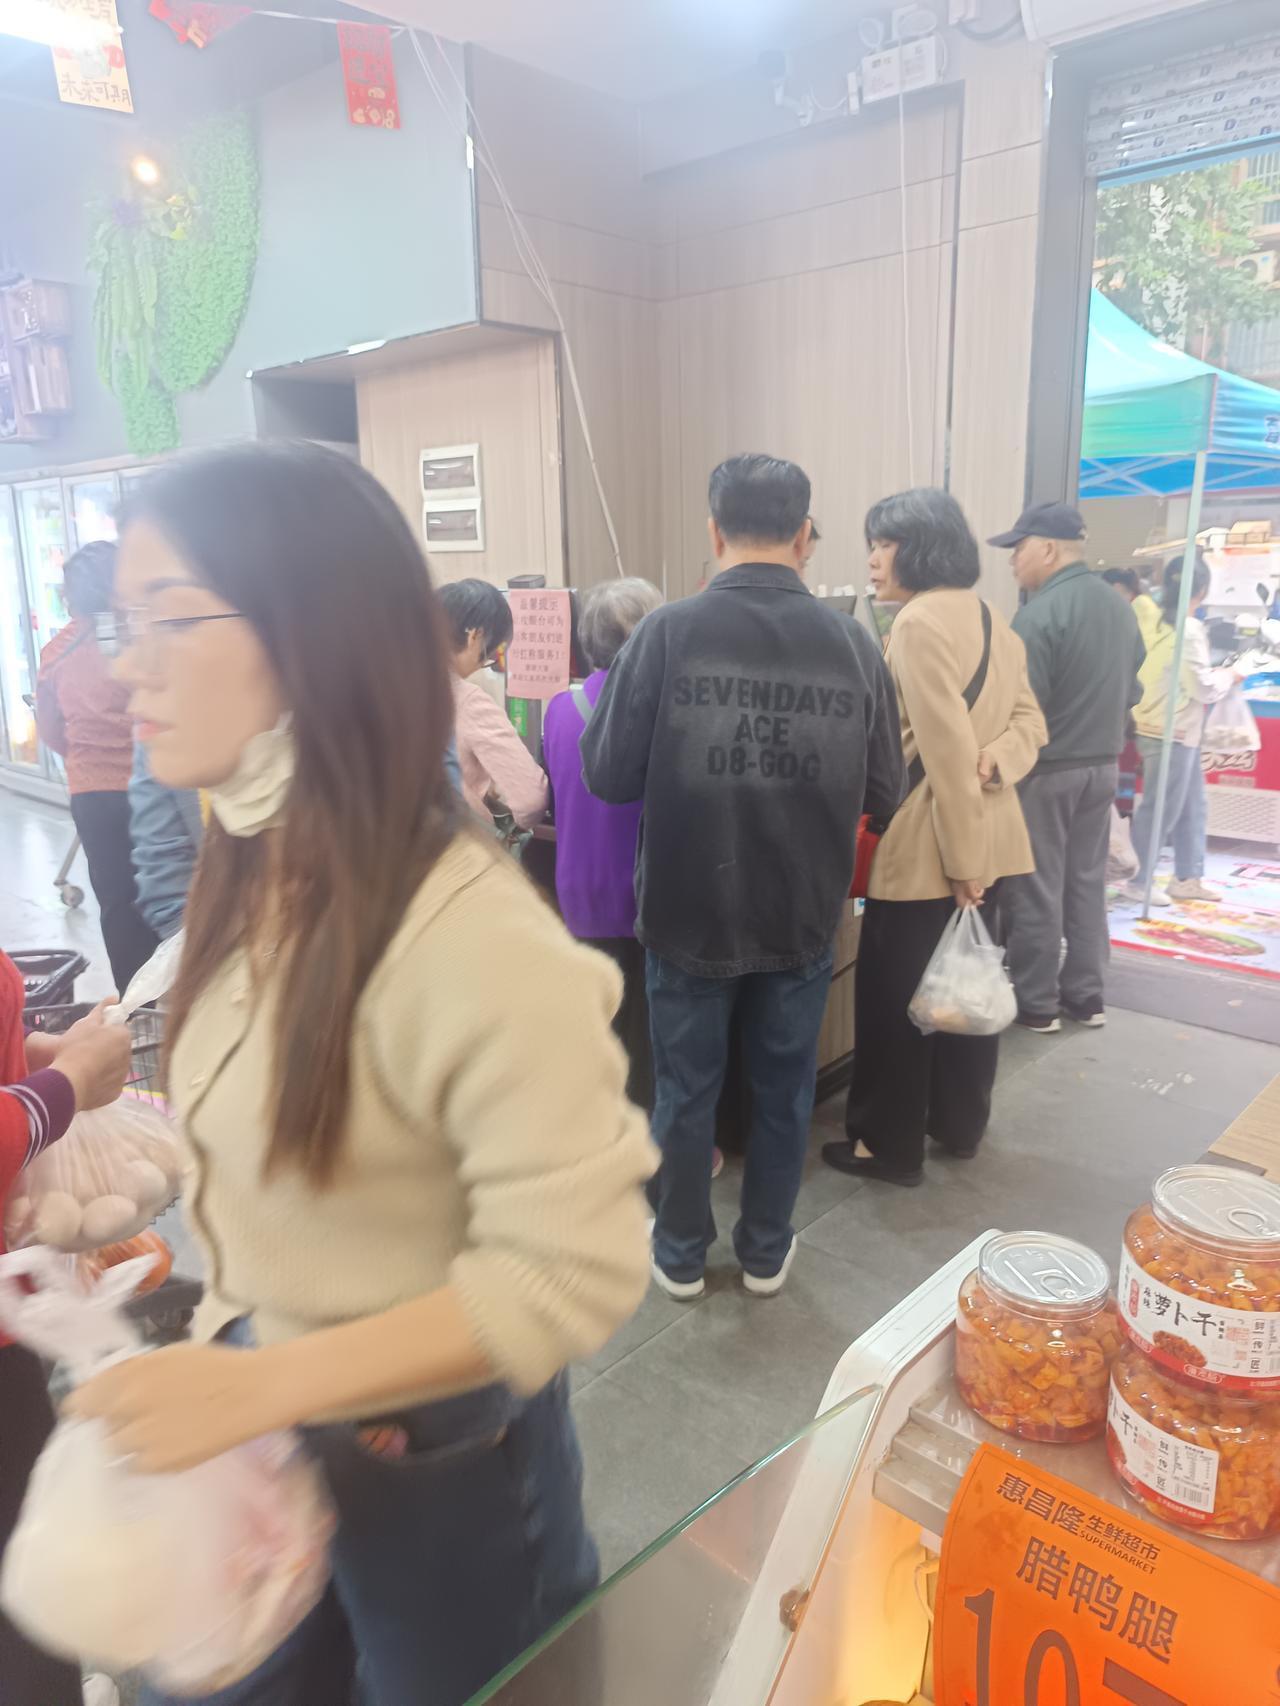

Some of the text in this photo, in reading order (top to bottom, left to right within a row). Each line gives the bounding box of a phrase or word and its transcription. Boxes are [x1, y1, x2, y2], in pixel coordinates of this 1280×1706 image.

[61, 72, 131, 106] 未来可期
[674, 675, 854, 720] SEVENDAYS
[734, 713, 790, 747] ACE
[1154, 1294, 1216, 1335] 萝卜干
[995, 1472, 1085, 1536] 惠昌隆
[1078, 1530, 1157, 1575] SUPERMARKET
[1085, 1514, 1161, 1560] 生鲜超市
[1015, 1536, 1179, 1665] 腊鸭腿
